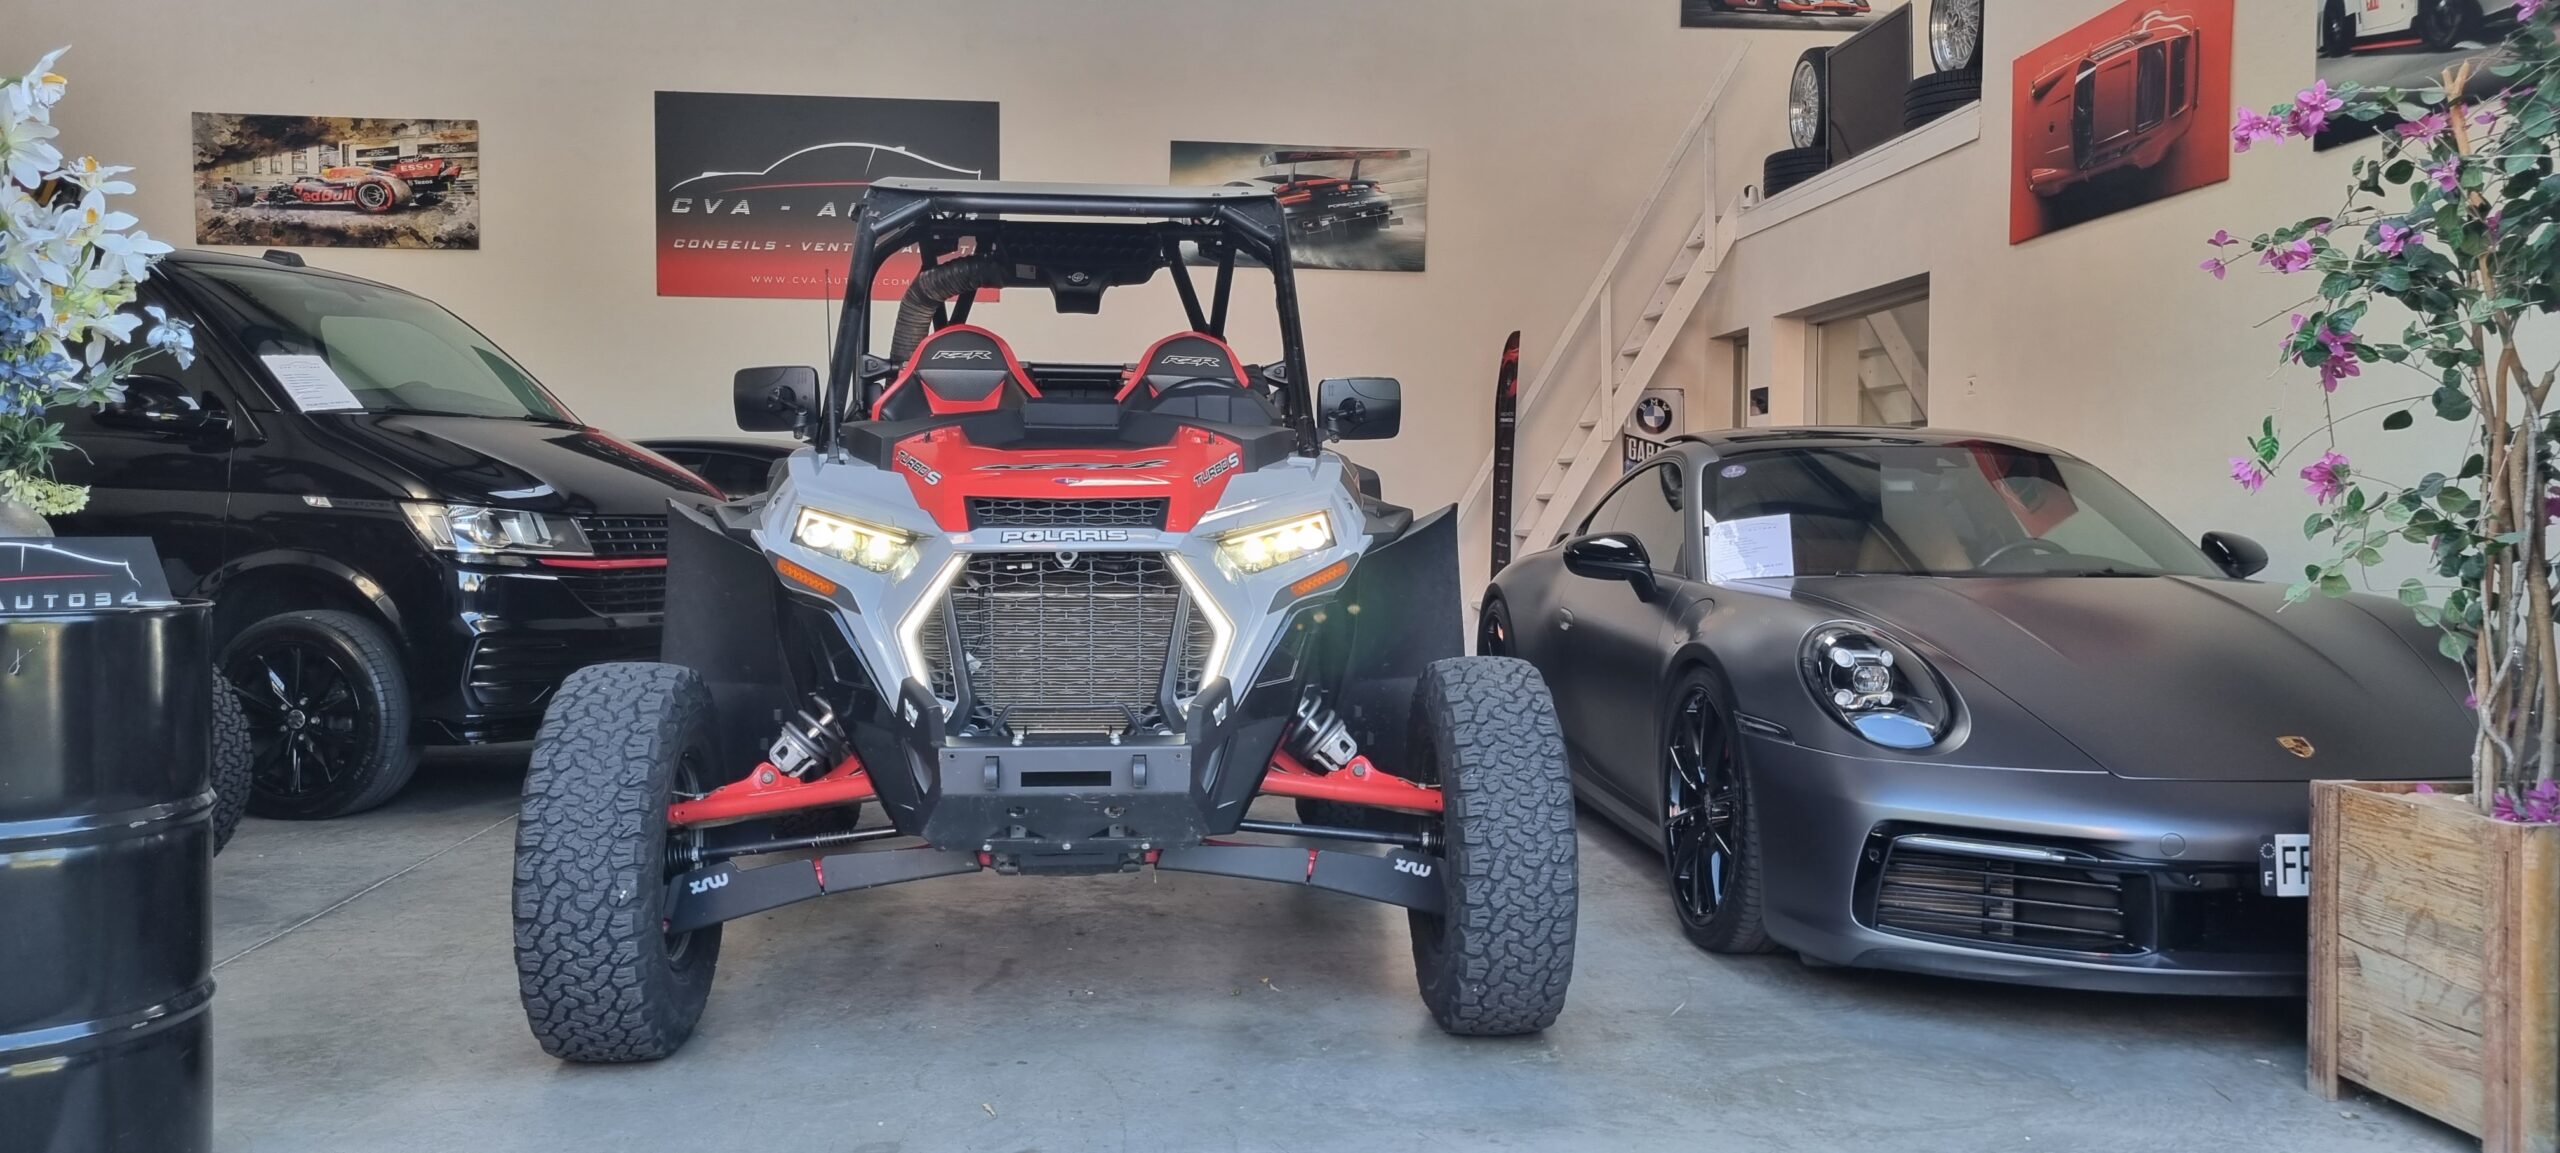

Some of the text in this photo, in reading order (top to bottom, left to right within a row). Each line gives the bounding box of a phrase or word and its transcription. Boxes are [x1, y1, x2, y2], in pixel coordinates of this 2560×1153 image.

[671, 197, 751, 215] CVA
[673, 238, 777, 250] CONSEILS
[801, 241, 853, 252] VENT
[931, 350, 992, 360] RZR
[1161, 355, 1220, 367] RZR
[1639, 398, 1671, 412] BMW
[896, 450, 931, 478] TURBO
[1193, 457, 1230, 488] TURBO
[1000, 530, 1128, 543] POLARIS
[0, 591, 138, 610] UTO34
[2264, 871, 2273, 886] F
